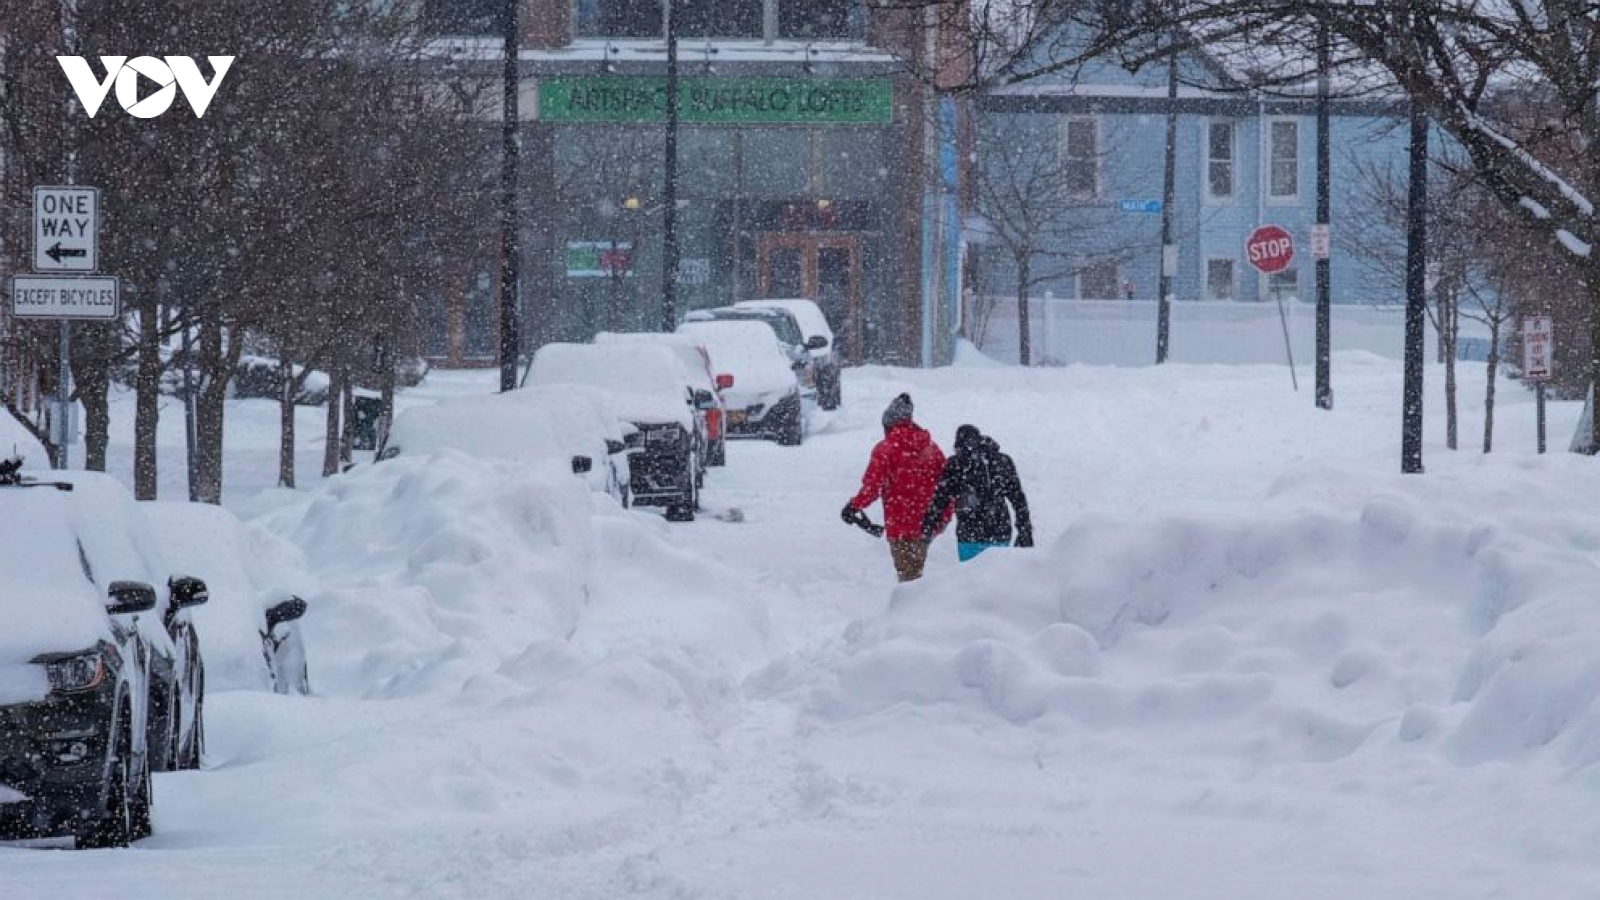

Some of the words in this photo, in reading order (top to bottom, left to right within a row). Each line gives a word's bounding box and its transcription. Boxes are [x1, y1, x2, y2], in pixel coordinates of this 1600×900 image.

[567, 88, 682, 111] ARTSPAC
[691, 88, 790, 111] BUFFALO
[797, 88, 864, 112] LOFTS
[42, 194, 88, 214] ONE
[41, 218, 88, 237] WAY
[1250, 237, 1290, 262] STOP
[15, 288, 56, 305] EXCEPT
[59, 289, 114, 306] BICYCLES
